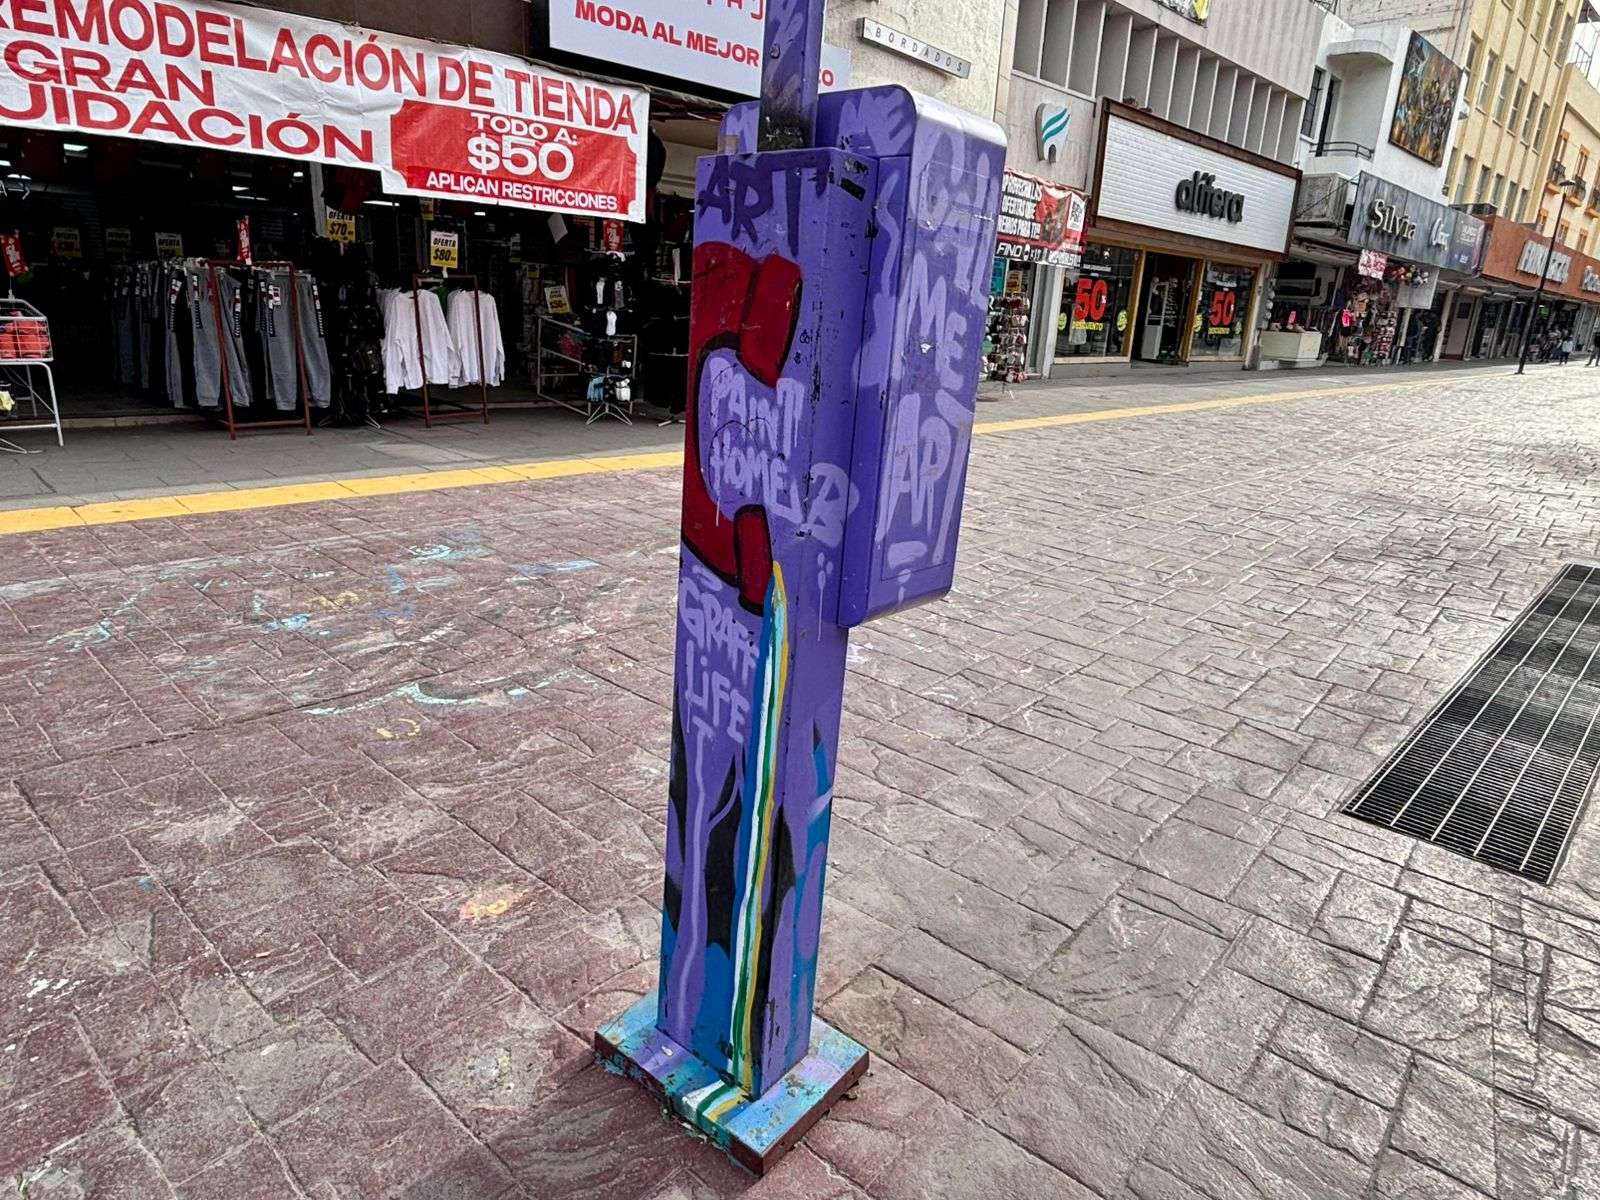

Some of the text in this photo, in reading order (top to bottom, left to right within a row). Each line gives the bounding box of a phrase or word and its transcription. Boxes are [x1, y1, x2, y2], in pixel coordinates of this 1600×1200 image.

[575, 0, 760, 67] MODA AL MEJOR
[875, 27, 962, 72] BORDADOS
[0, 0, 638, 134] EMODELACIÓN DE TIENDA
[4, 40, 216, 106] GRAN
[471, 112, 578, 146] TODO A:
[466, 133, 574, 182] $50
[426, 171, 618, 211] APLICAN RESTRICCIONES
[1371, 199, 1417, 241] Silvia
[432, 238, 457, 248] OFERTA
[1074, 278, 1109, 322] 50
[1210, 290, 1237, 326] 50
